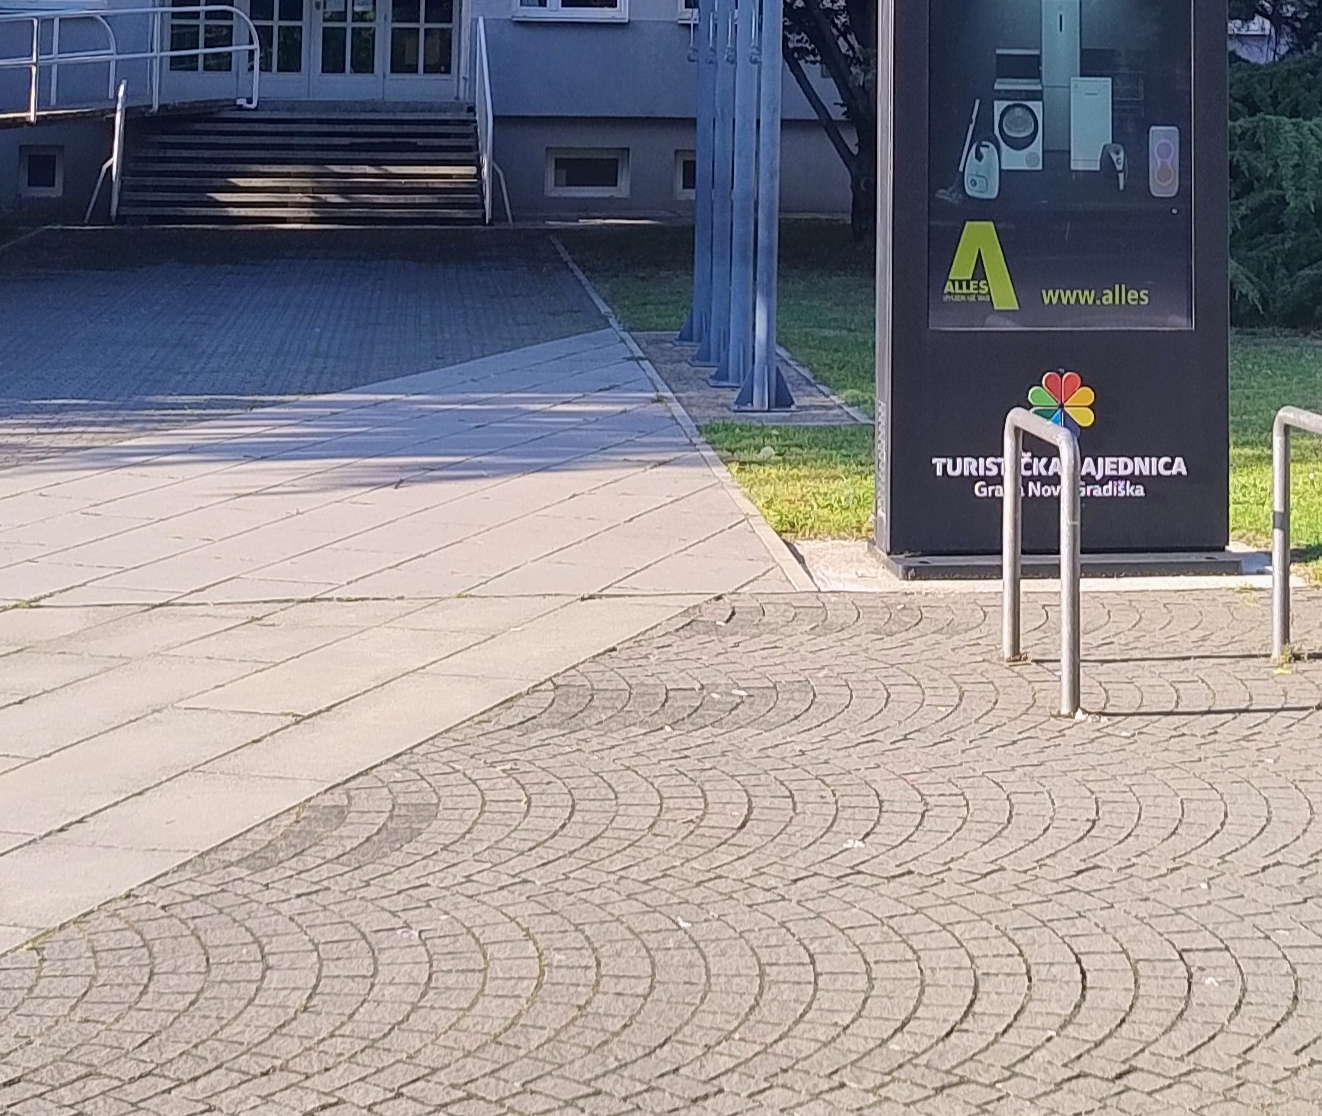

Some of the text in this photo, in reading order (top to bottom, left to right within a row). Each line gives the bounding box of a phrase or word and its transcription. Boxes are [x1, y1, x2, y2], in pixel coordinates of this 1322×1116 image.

[943, 281, 989, 294] ALLES
[1041, 284, 1149, 305] www.alles
[1080, 457, 1188, 481] AJEDNICA
[1028, 481, 1062, 497] Nov
